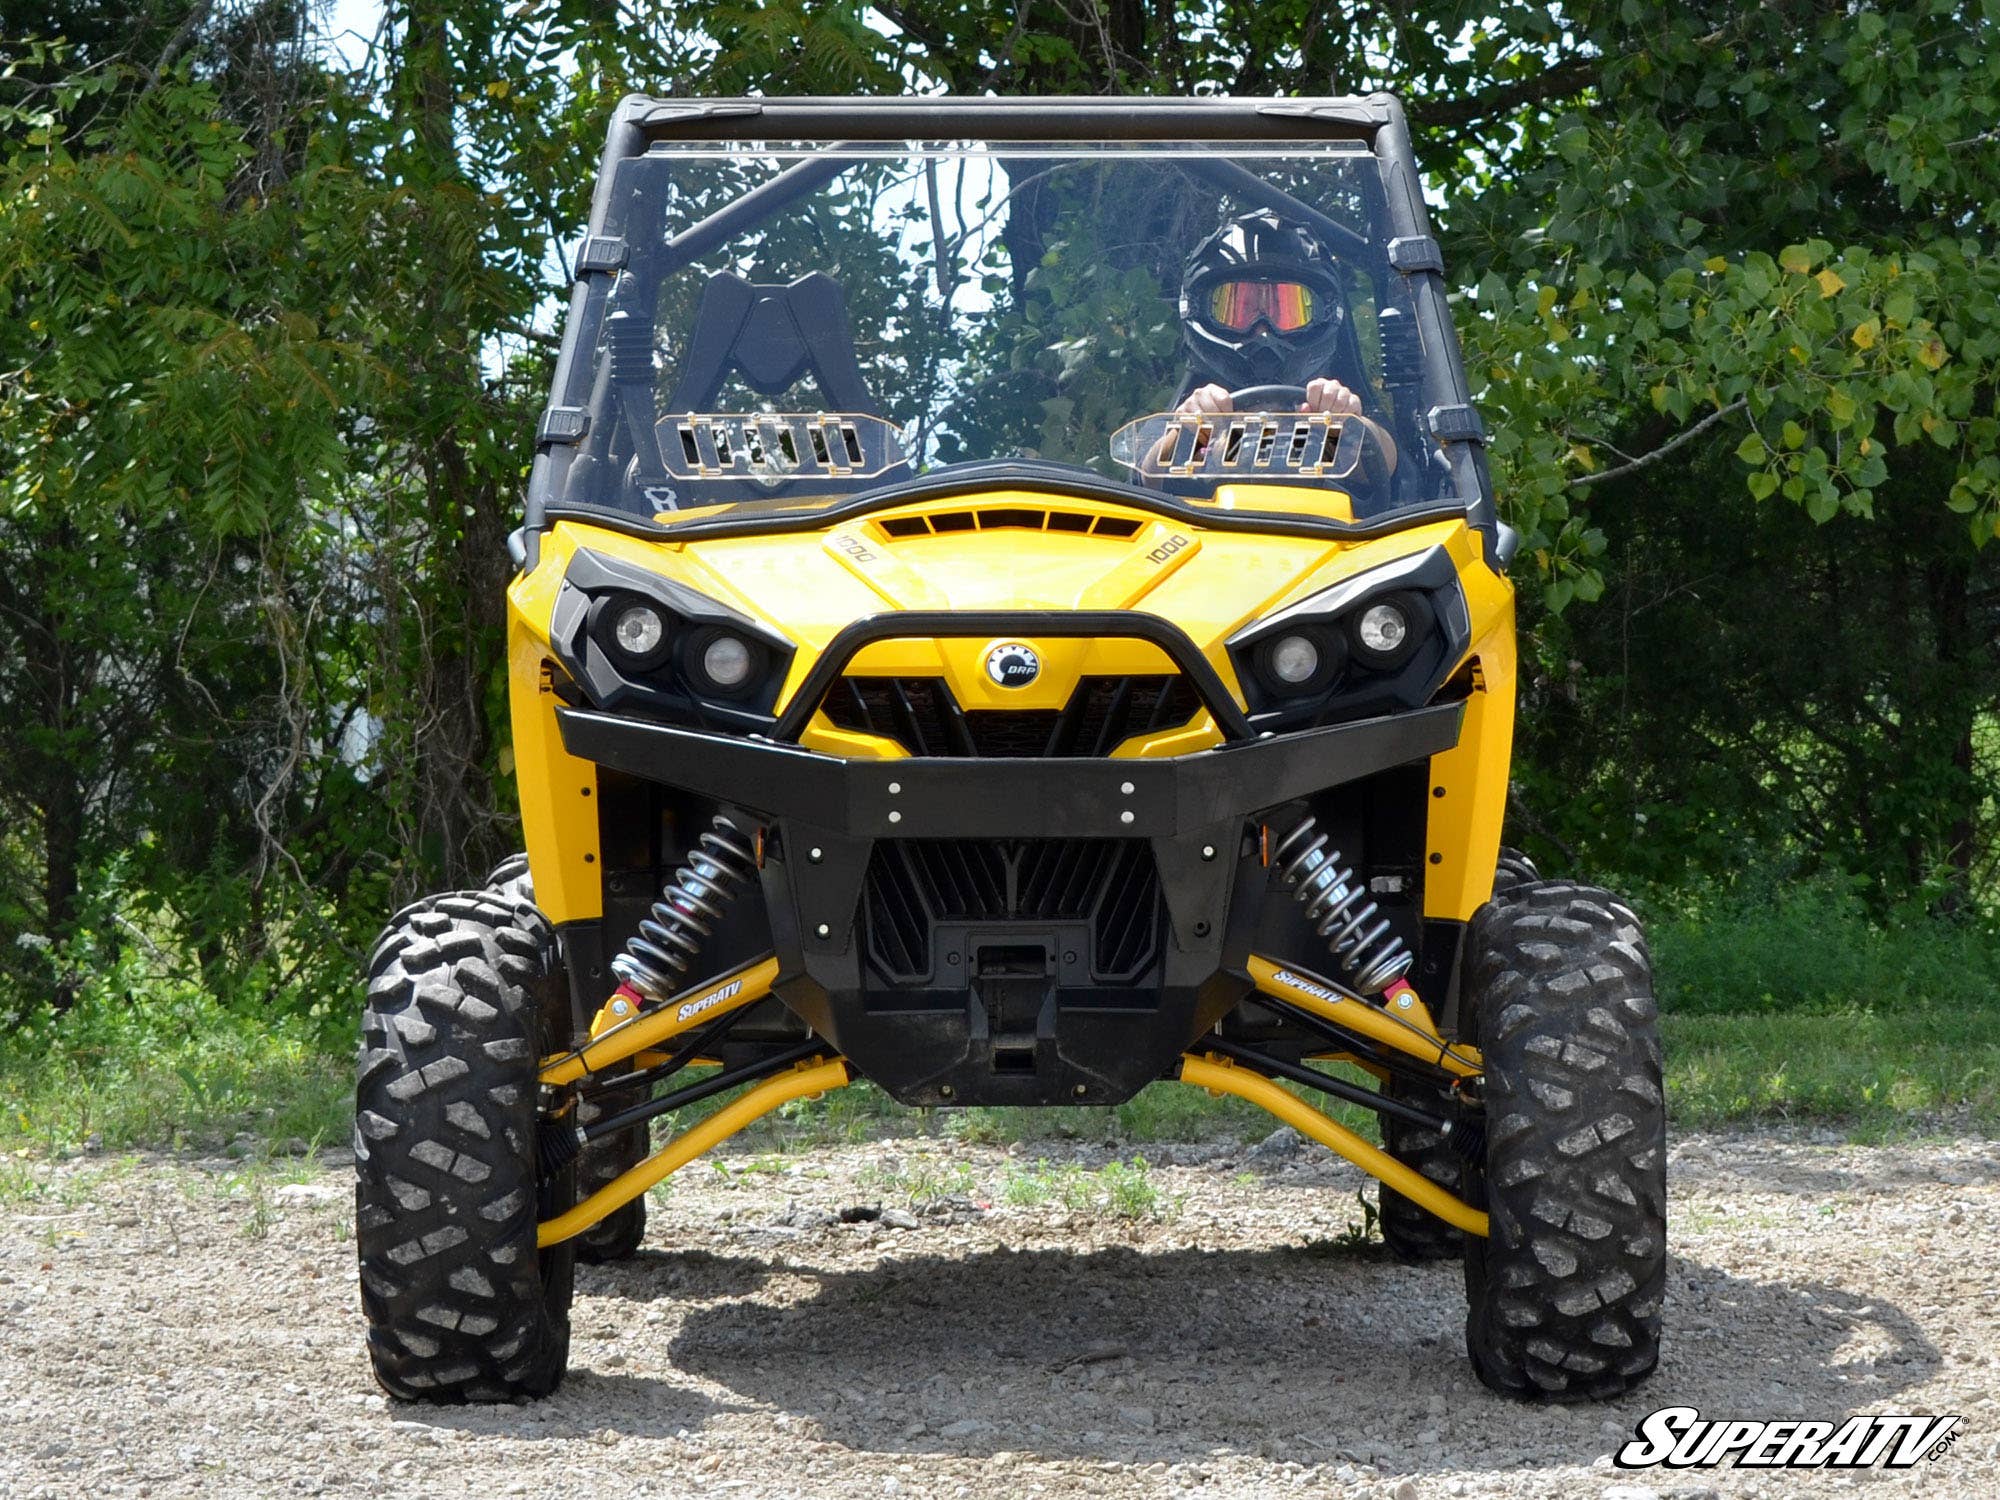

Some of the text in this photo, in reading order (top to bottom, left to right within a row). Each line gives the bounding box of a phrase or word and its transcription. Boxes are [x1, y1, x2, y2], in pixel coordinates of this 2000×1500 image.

[1145, 534, 1188, 565] 1000
[678, 980, 742, 1022] SUPERATV
[1272, 970, 1343, 1003] SUPERATV
